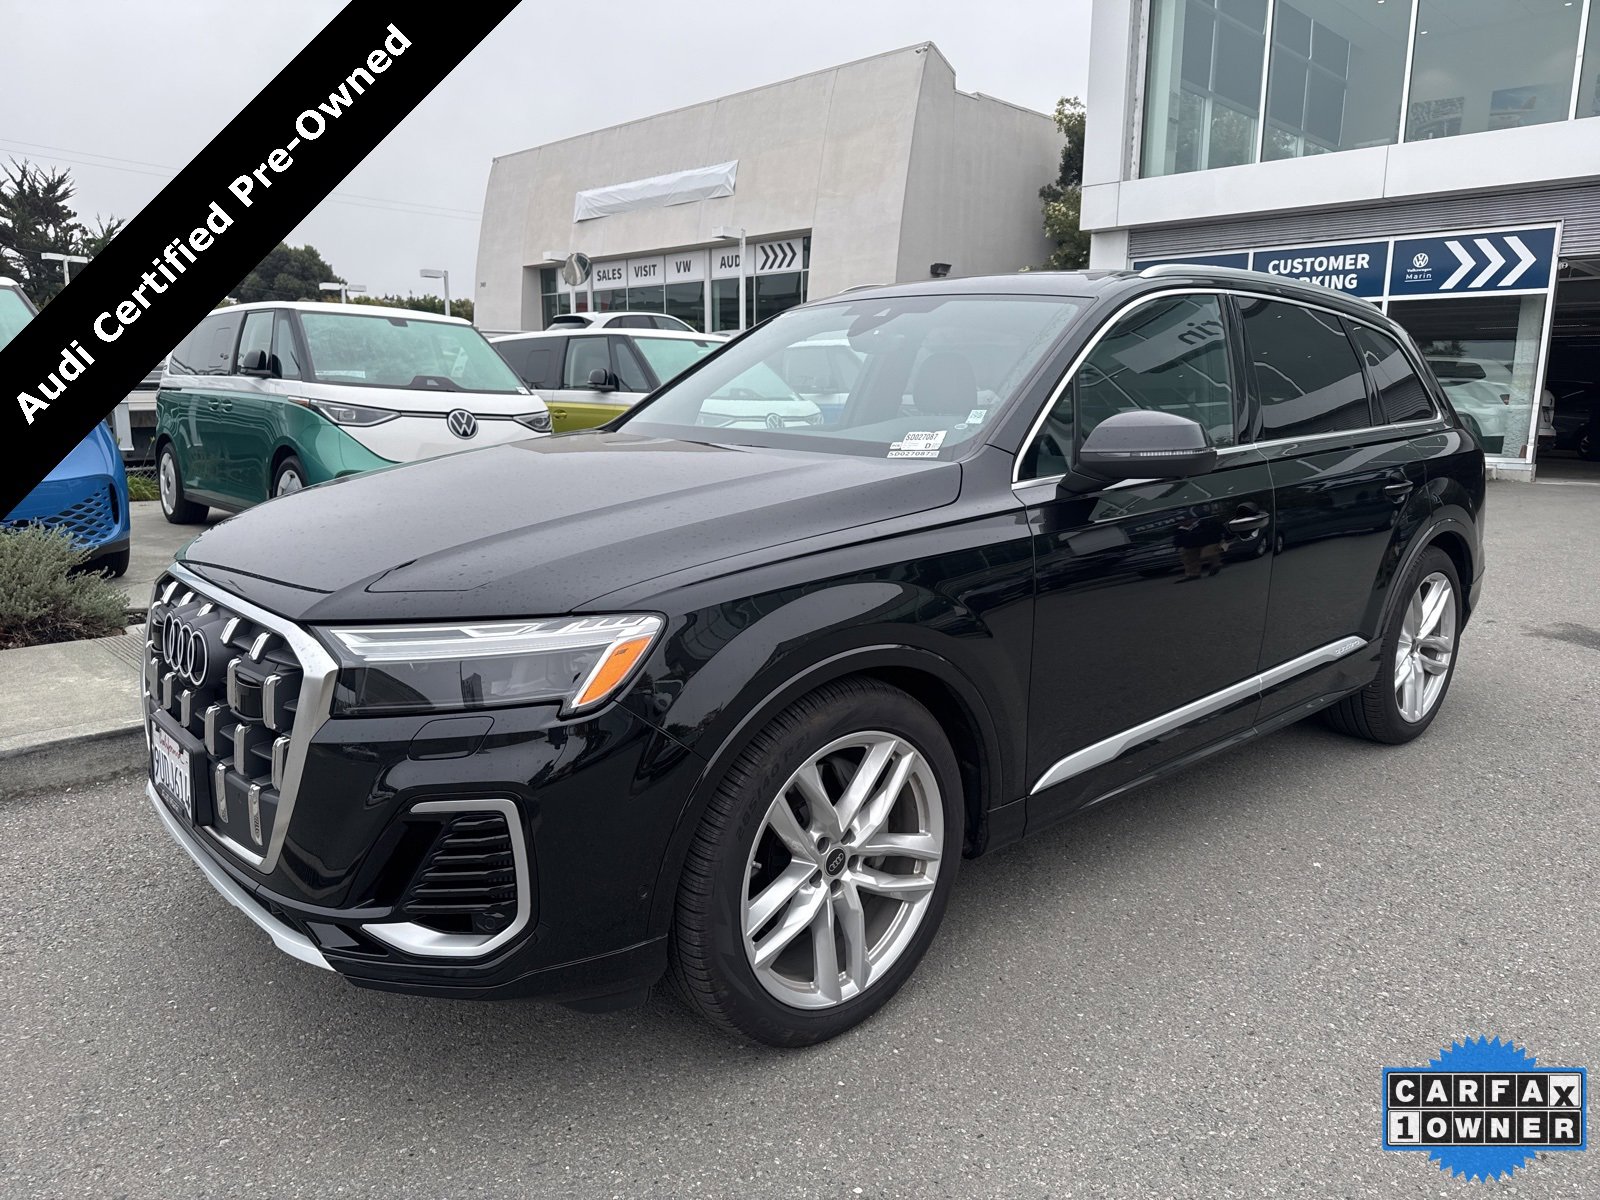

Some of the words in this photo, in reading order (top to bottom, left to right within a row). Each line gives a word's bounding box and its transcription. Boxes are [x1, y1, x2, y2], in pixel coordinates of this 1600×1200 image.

[596, 268, 622, 282] SALES
[634, 264, 657, 279] VISIT
[675, 260, 692, 274] VW
[719, 254, 741, 269] AUD
[1268, 253, 1370, 275] CUSTOMER
[1405, 272, 1432, 280] Marin
